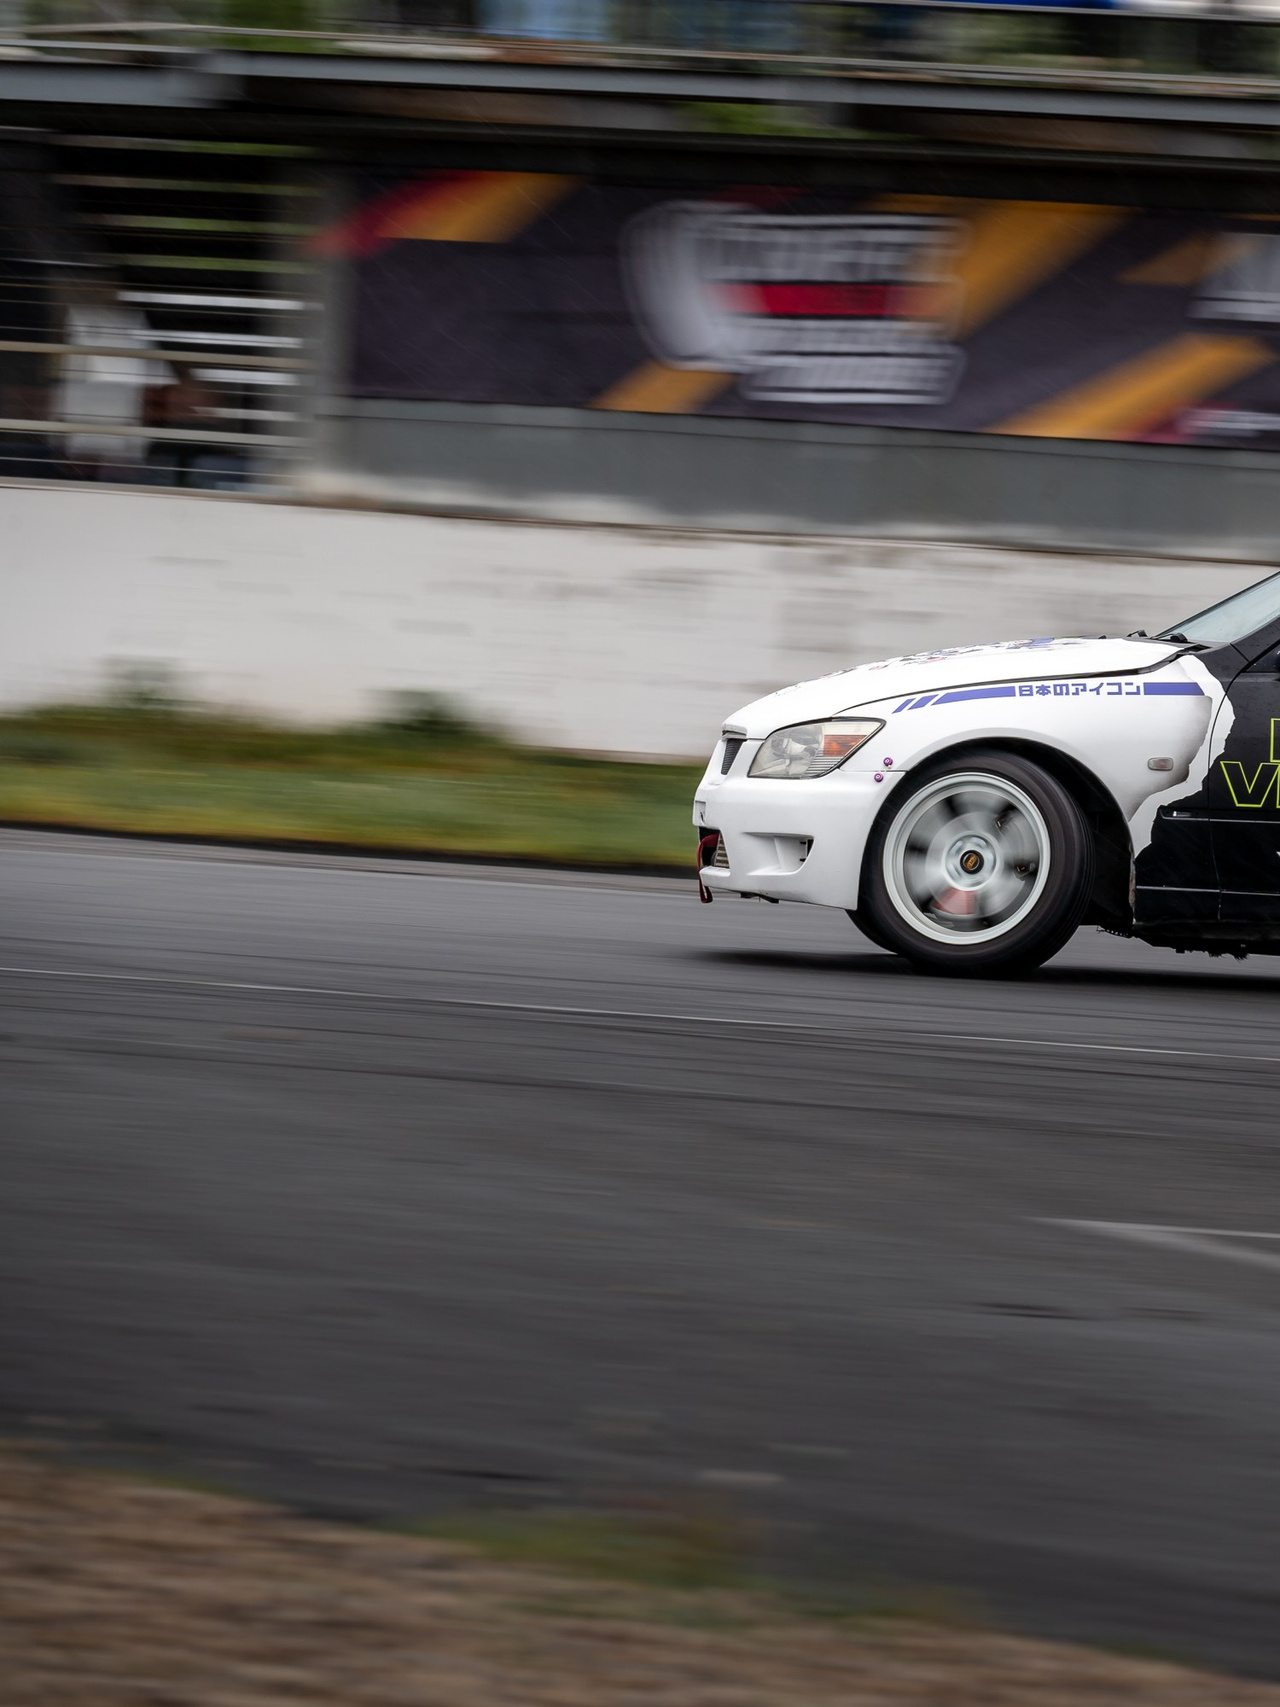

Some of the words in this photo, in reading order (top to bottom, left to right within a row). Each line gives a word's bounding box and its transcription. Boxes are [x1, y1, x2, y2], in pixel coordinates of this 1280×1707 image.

[1018, 682, 1141, 697] 日本のアイコン
